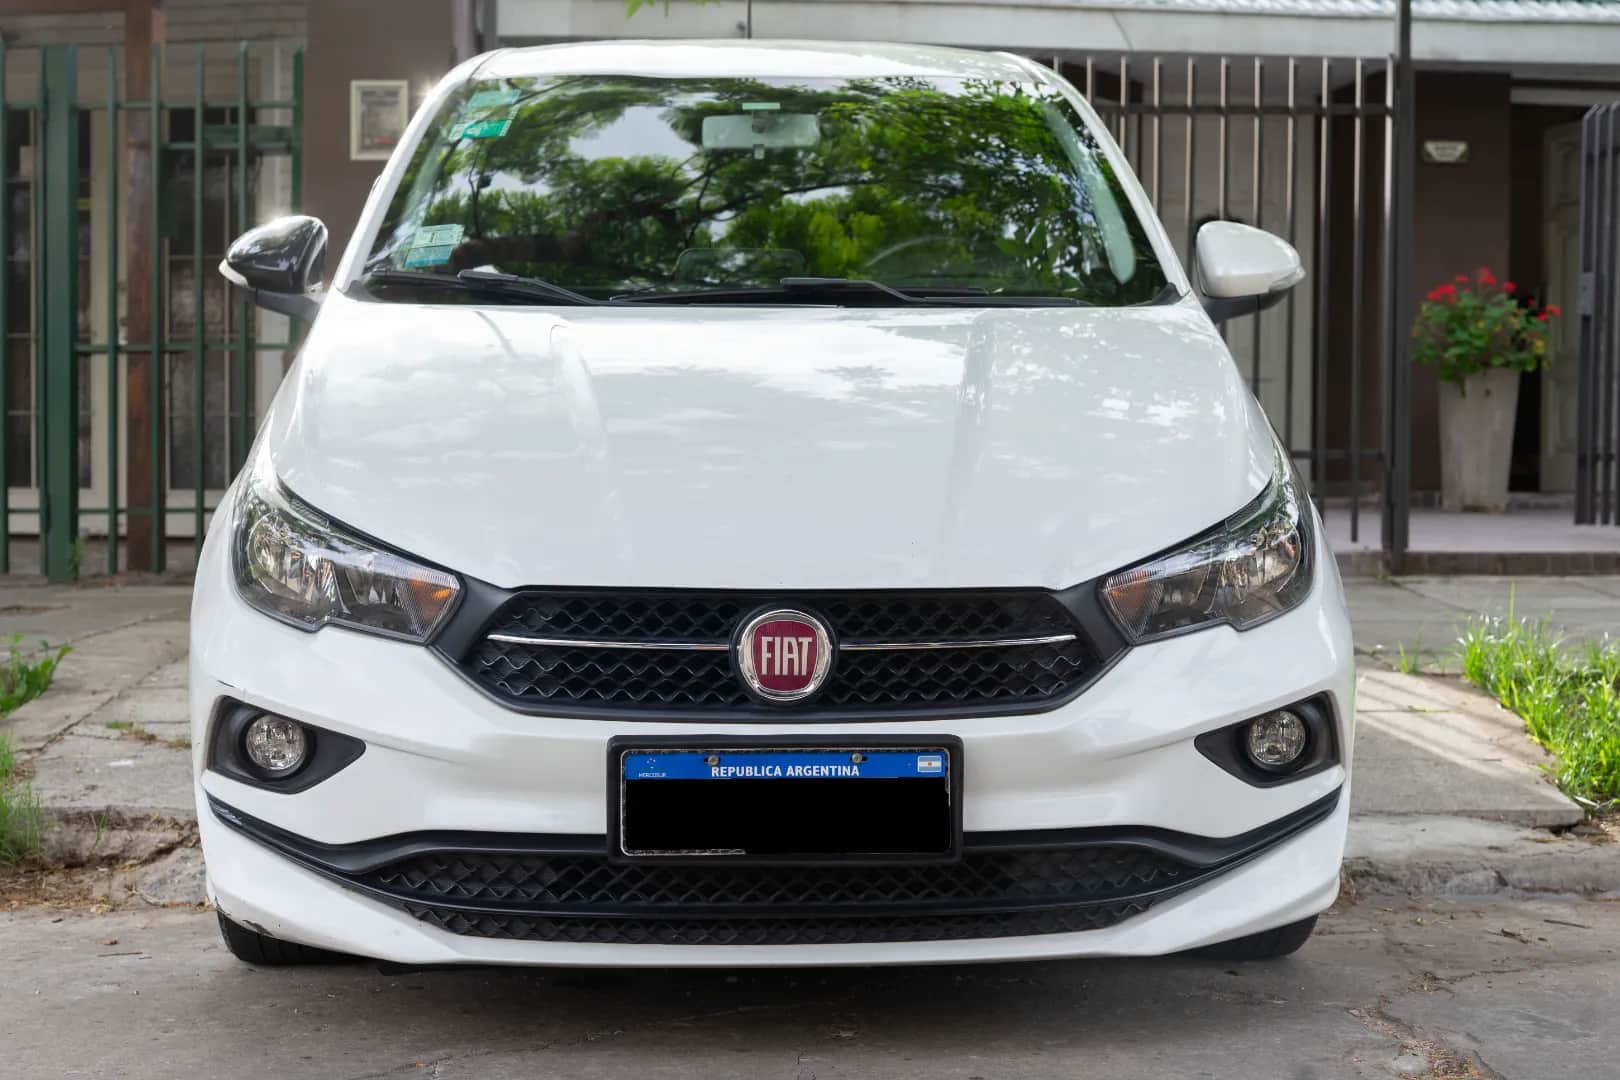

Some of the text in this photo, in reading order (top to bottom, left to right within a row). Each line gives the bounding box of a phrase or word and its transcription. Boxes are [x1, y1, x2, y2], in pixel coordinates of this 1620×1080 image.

[761, 636, 813, 676] FIAT
[711, 765, 860, 777] REPUBLICA ARGENTINA
